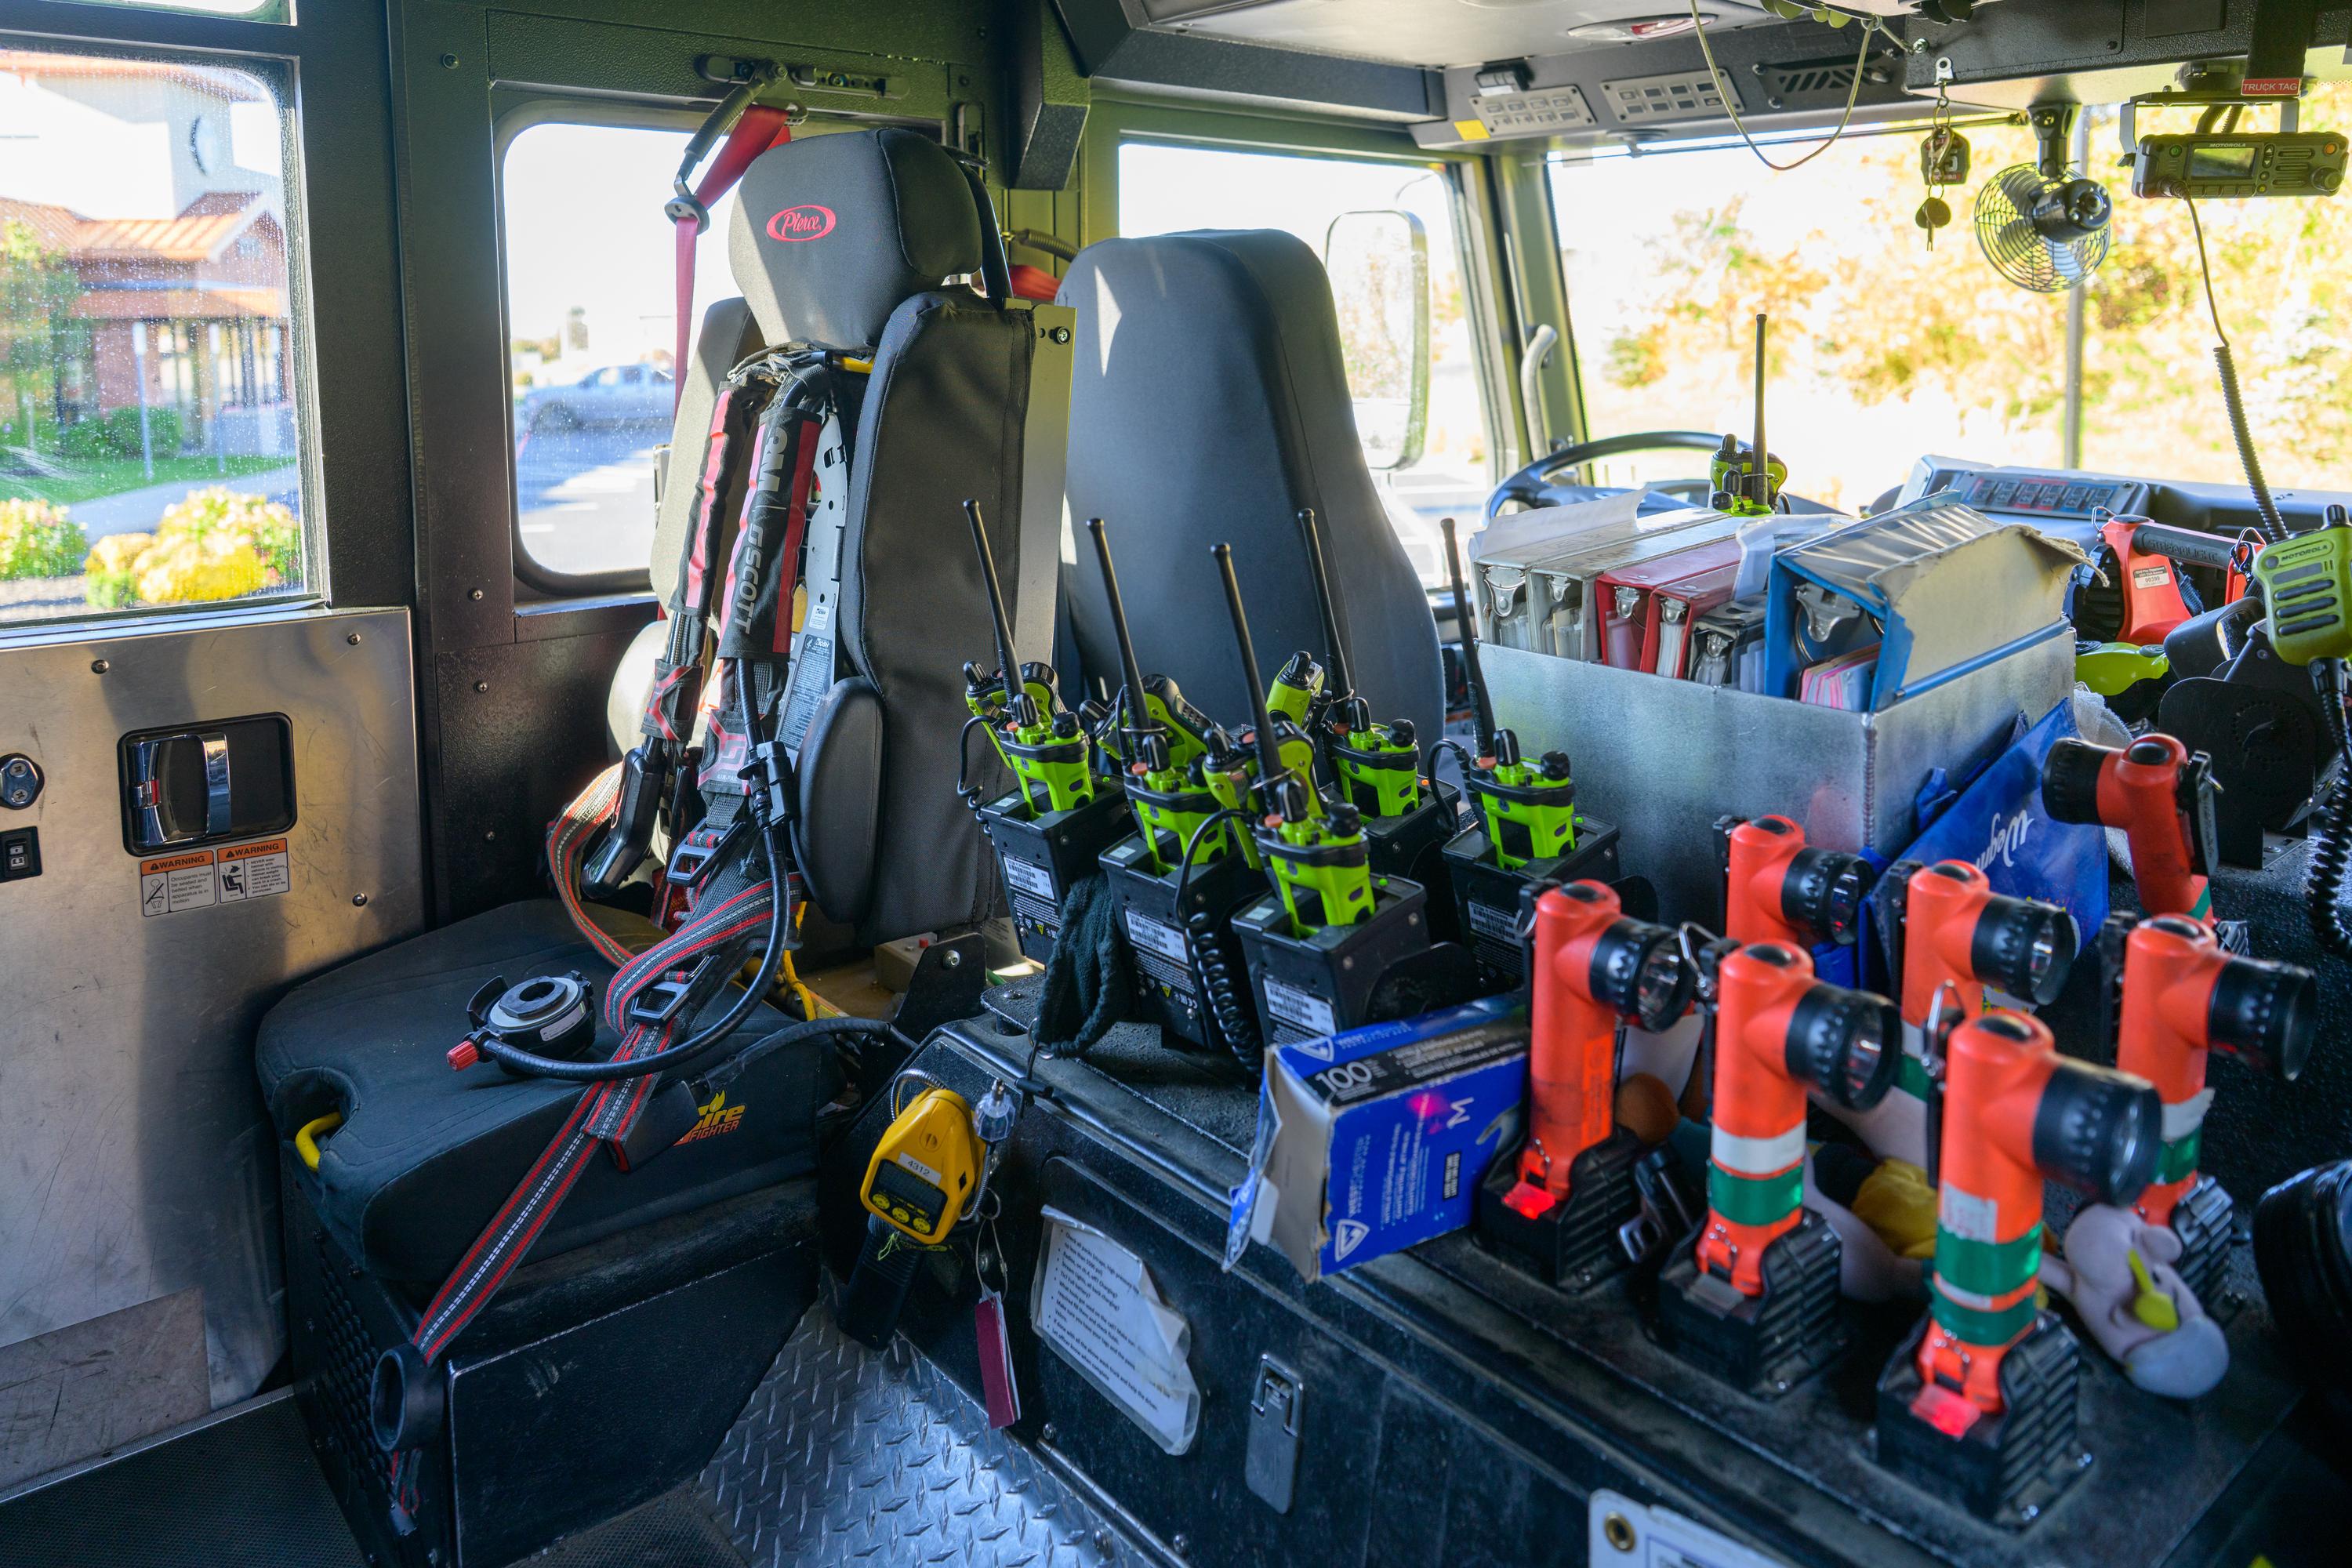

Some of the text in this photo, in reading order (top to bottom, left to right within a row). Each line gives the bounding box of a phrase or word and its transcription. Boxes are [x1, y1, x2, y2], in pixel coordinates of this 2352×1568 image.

[2243, 82, 2298, 91] TRUCK TAG
[781, 212, 819, 238] Pierce
[757, 426, 787, 492] 3M
[2281, 545, 2328, 561] MOTOROLA
[734, 548, 763, 634] SCOTT
[235, 844, 279, 856] WARNING
[159, 855, 205, 869] WARNING
[1315, 1062, 1372, 1093] 100
[1446, 1097, 1474, 1129] M
[689, 1119, 741, 1142] FIGHTER
[908, 1160, 930, 1176] 4312
[1065, 1232, 1076, 1244] Check
